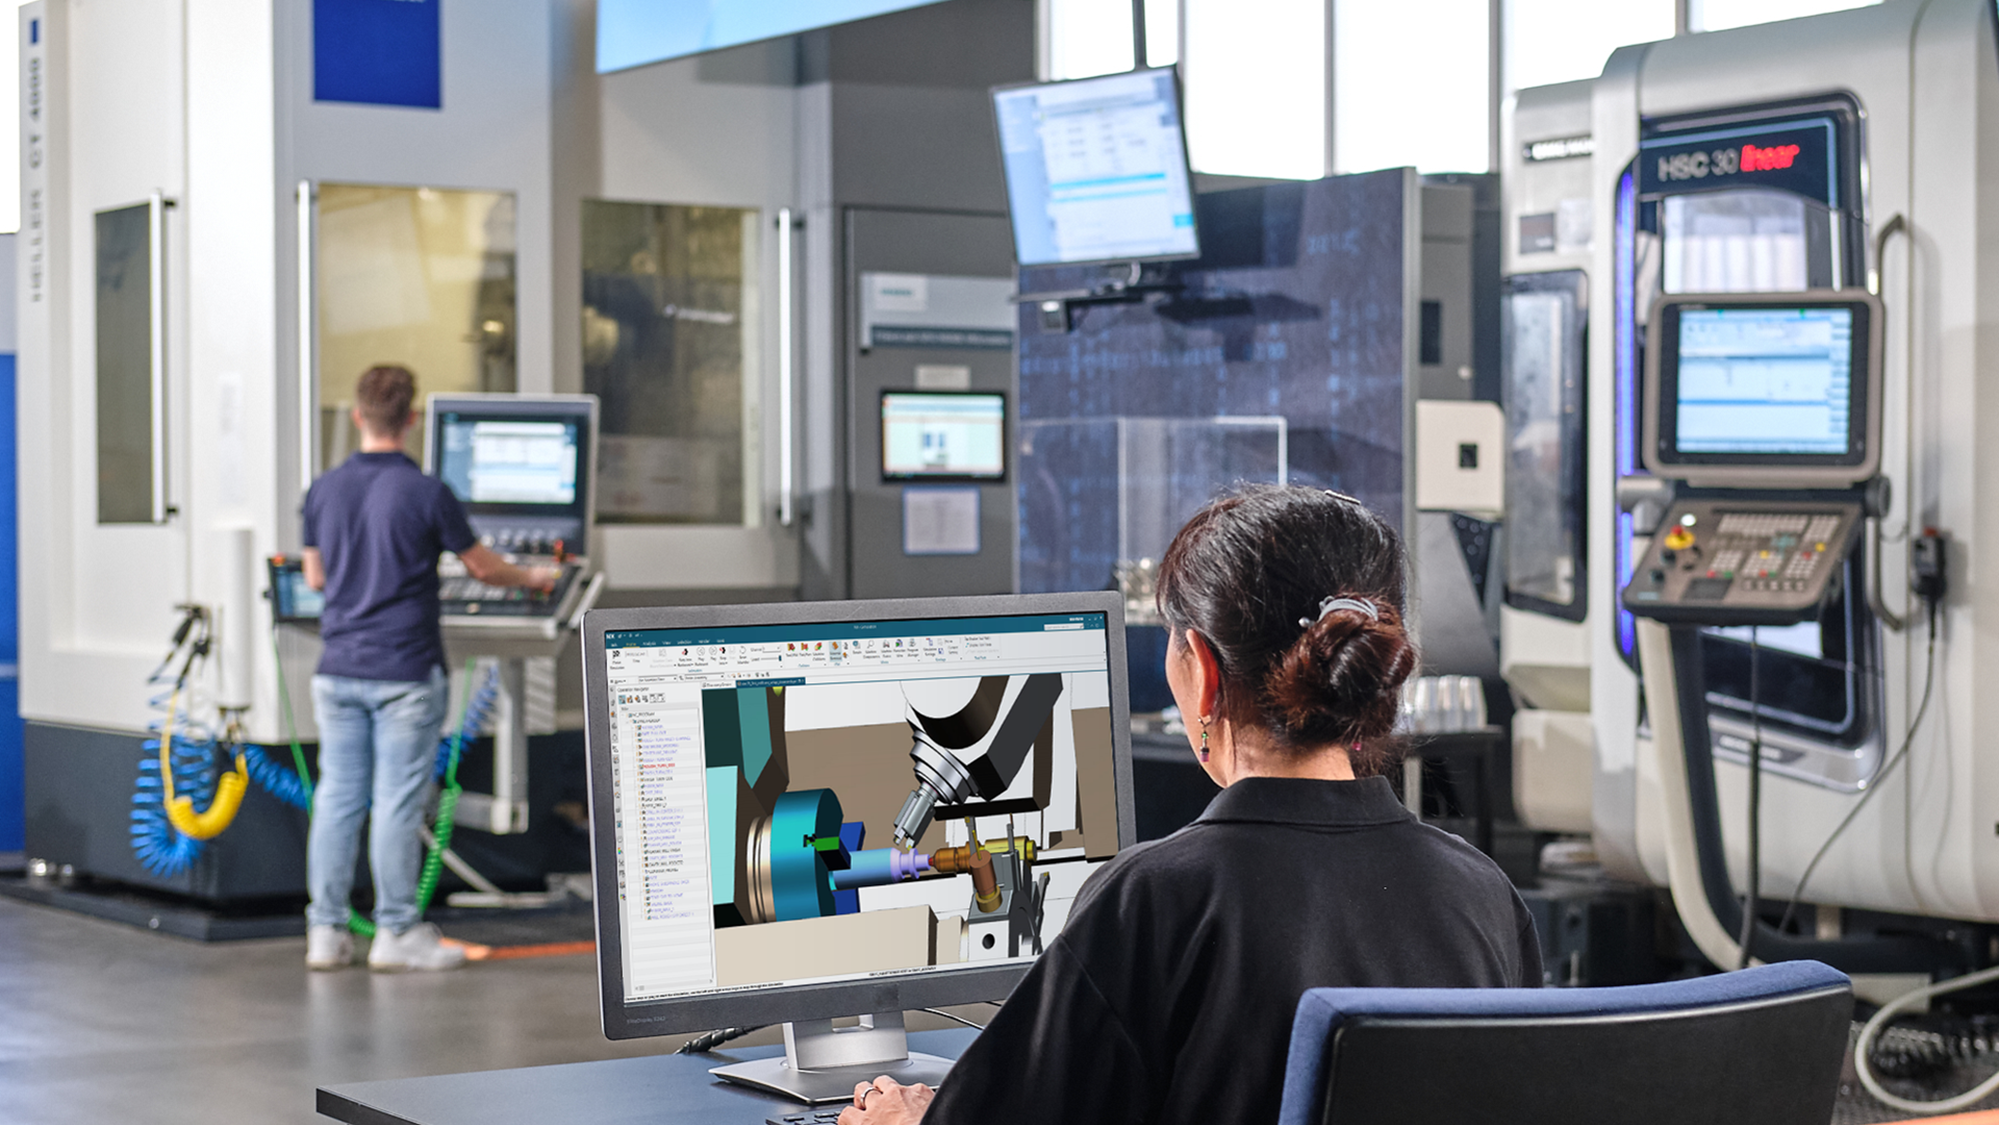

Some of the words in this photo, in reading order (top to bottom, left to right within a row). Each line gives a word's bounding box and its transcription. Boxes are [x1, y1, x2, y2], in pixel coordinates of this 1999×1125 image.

[1657, 150, 1710, 182] HSC
[1710, 147, 1740, 176] 30
[1739, 144, 1800, 172] linear
